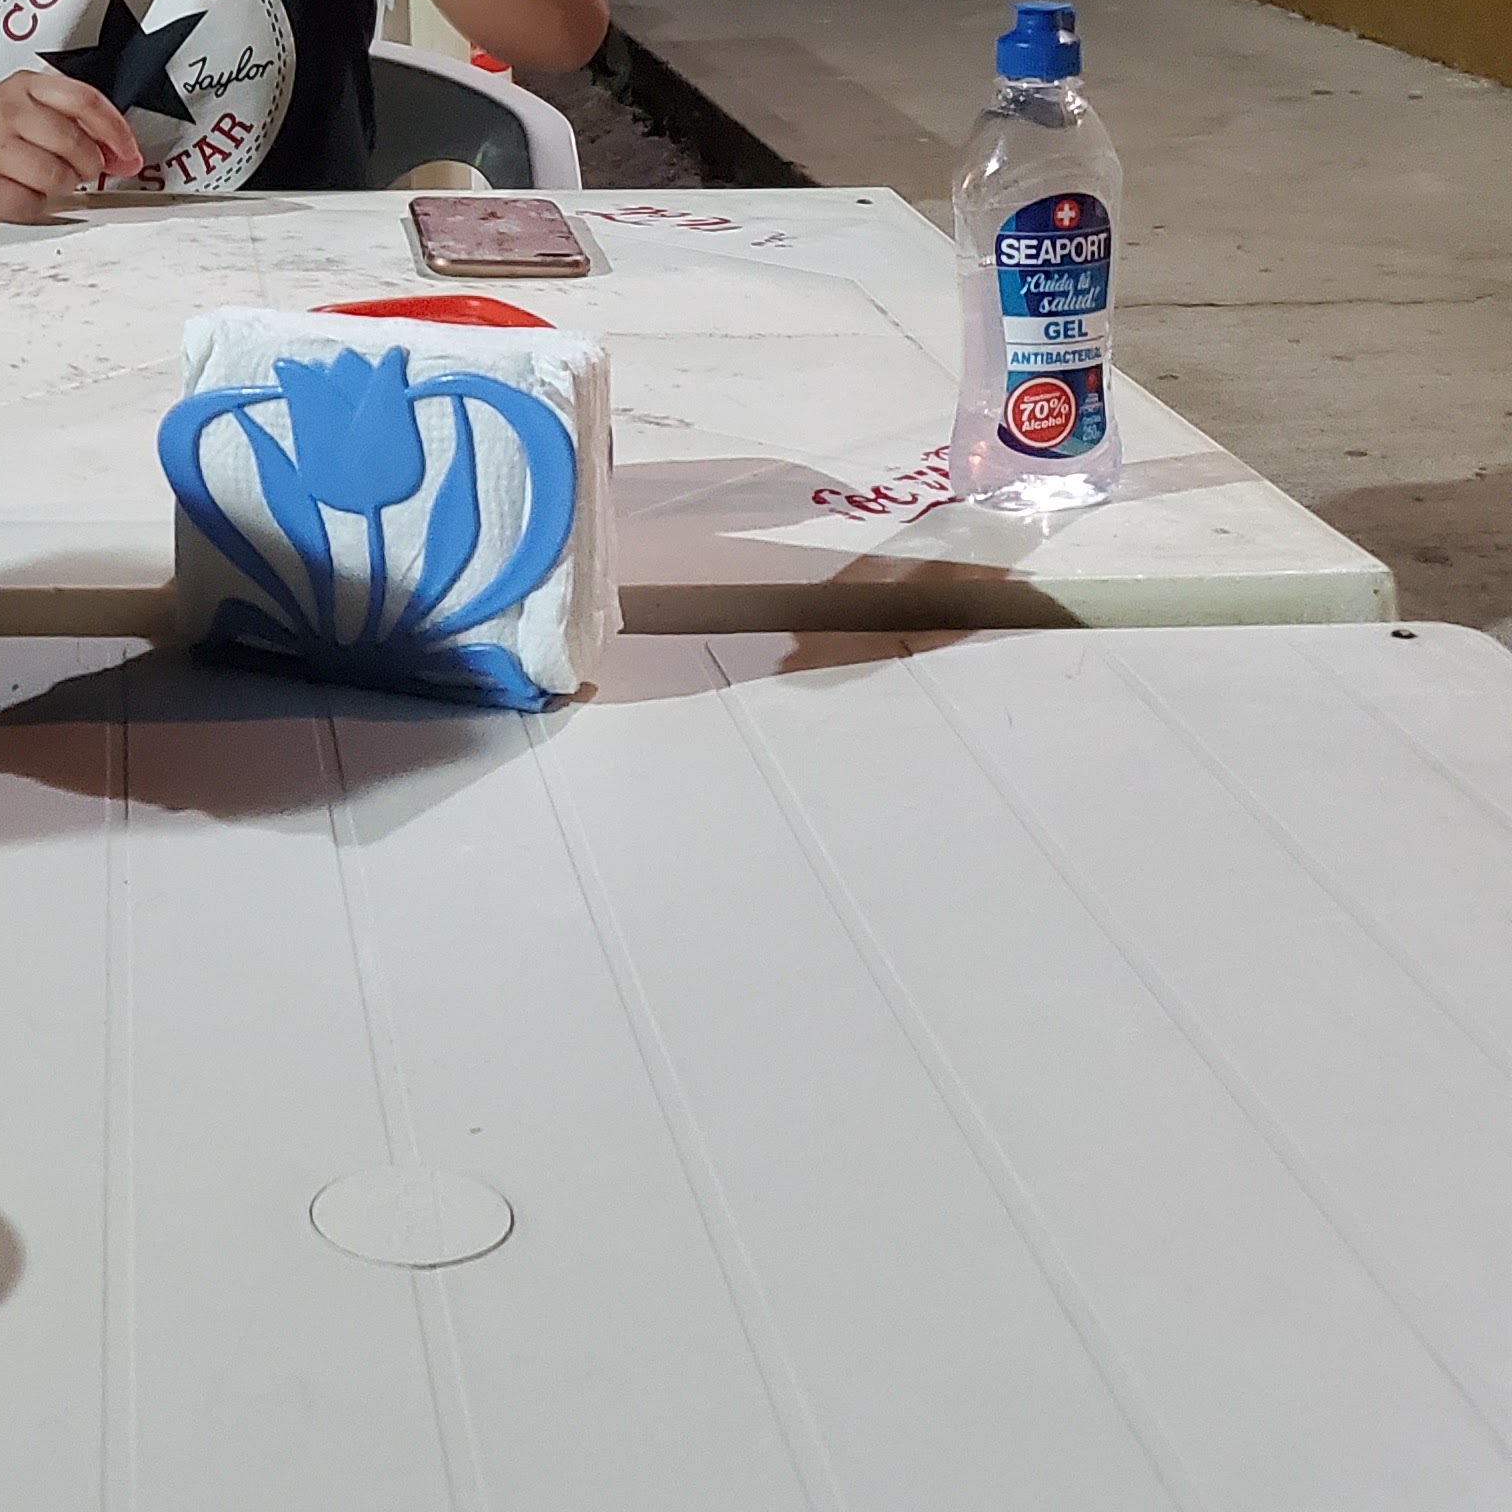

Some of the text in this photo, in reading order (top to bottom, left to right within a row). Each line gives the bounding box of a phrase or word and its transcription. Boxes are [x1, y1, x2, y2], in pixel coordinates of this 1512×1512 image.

[183, 45, 275, 98] Taylor
[140, 111, 254, 191] STAR
[999, 233, 1109, 266] SEAPORT
[1038, 286, 1101, 313] salud!
[1043, 319, 1088, 340] GEL
[1019, 396, 1070, 421] 70%
[1021, 414, 1066, 431] Alcohol
